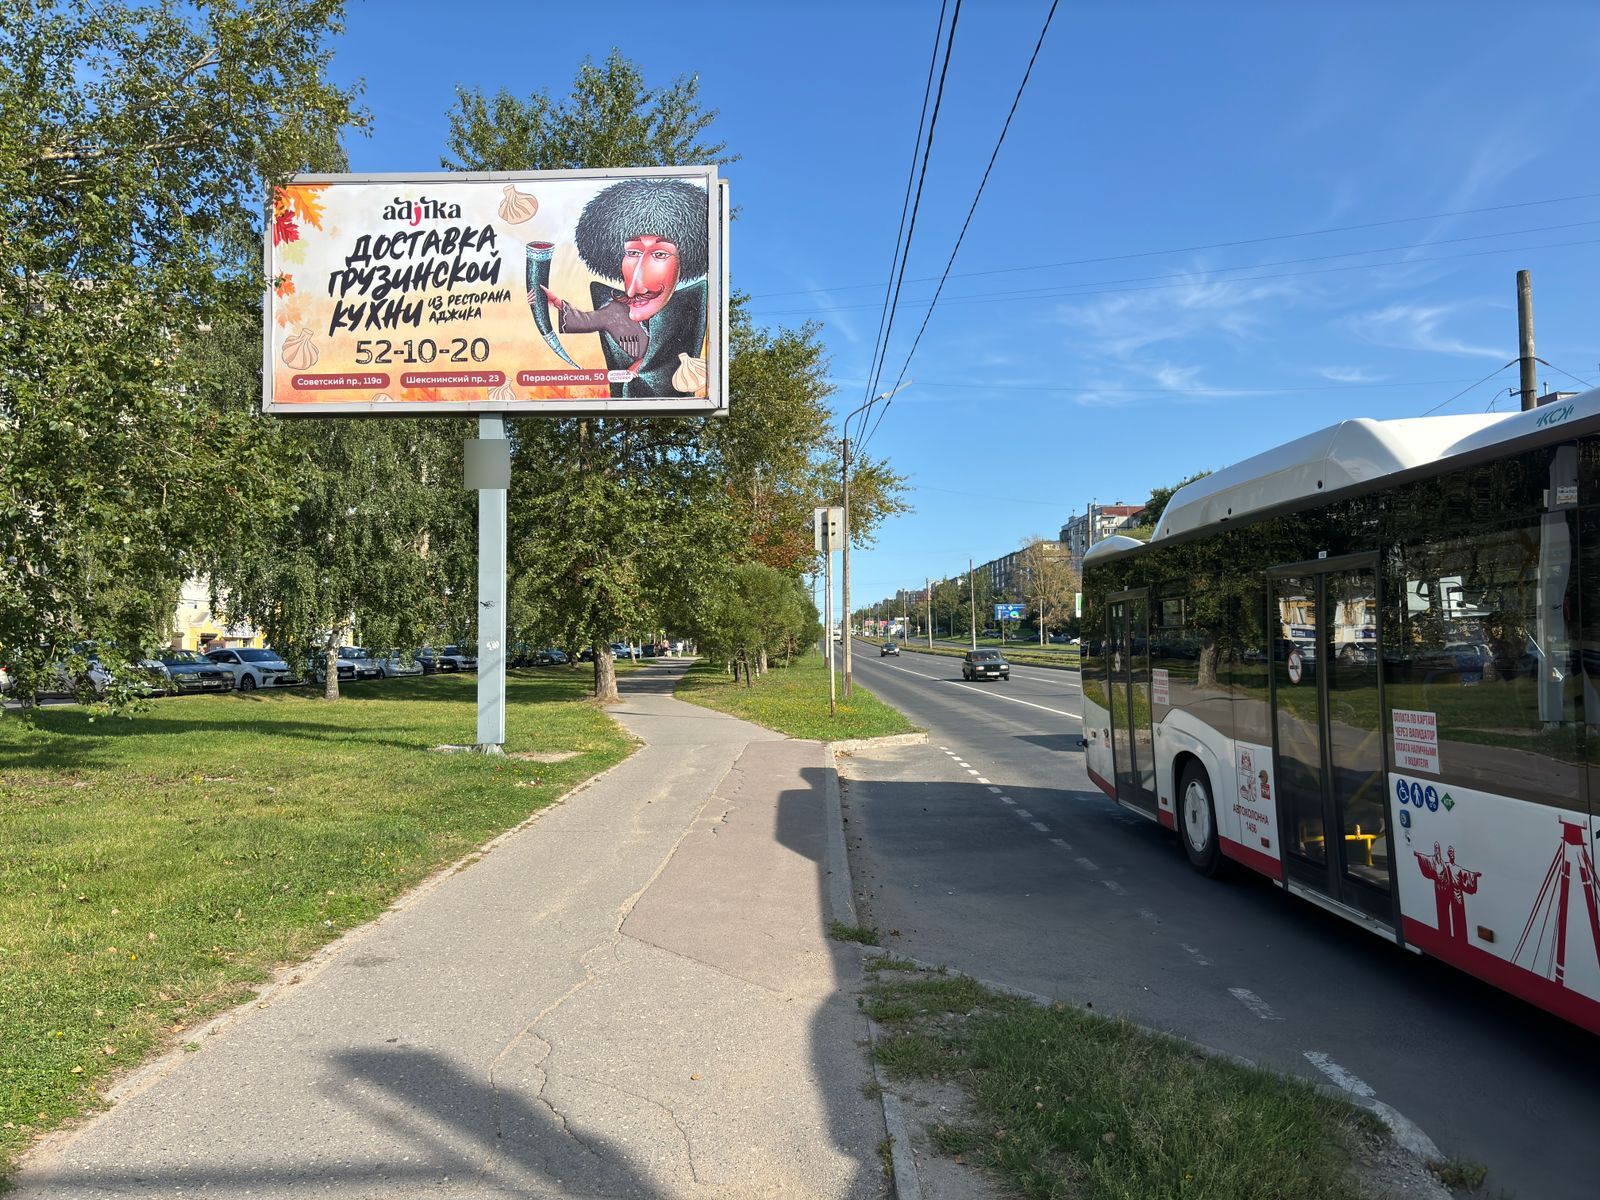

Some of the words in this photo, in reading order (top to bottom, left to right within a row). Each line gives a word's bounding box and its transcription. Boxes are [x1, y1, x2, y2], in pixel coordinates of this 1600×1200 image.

[382, 196, 462, 226] adjika
[345, 224, 498, 268] ДОСТАВКА
[328, 250, 502, 300] ГРУЗИНСКОЙ
[428, 295, 444, 310] ИЗ
[447, 289, 512, 308] РЕСТОРАНА
[328, 294, 424, 337] КУХНИ
[428, 306, 482, 325] АДЖИКА
[355, 337, 490, 365] 52-10-20
[297, 377, 345, 386] Советский
[406, 375, 469, 384] Шекснинский
[488, 374, 500, 383] 23
[522, 373, 592, 383] Первомайская,
[594, 373, 605, 381] 50
[1232, 803, 1269, 825] АВТОКОЛОННА
